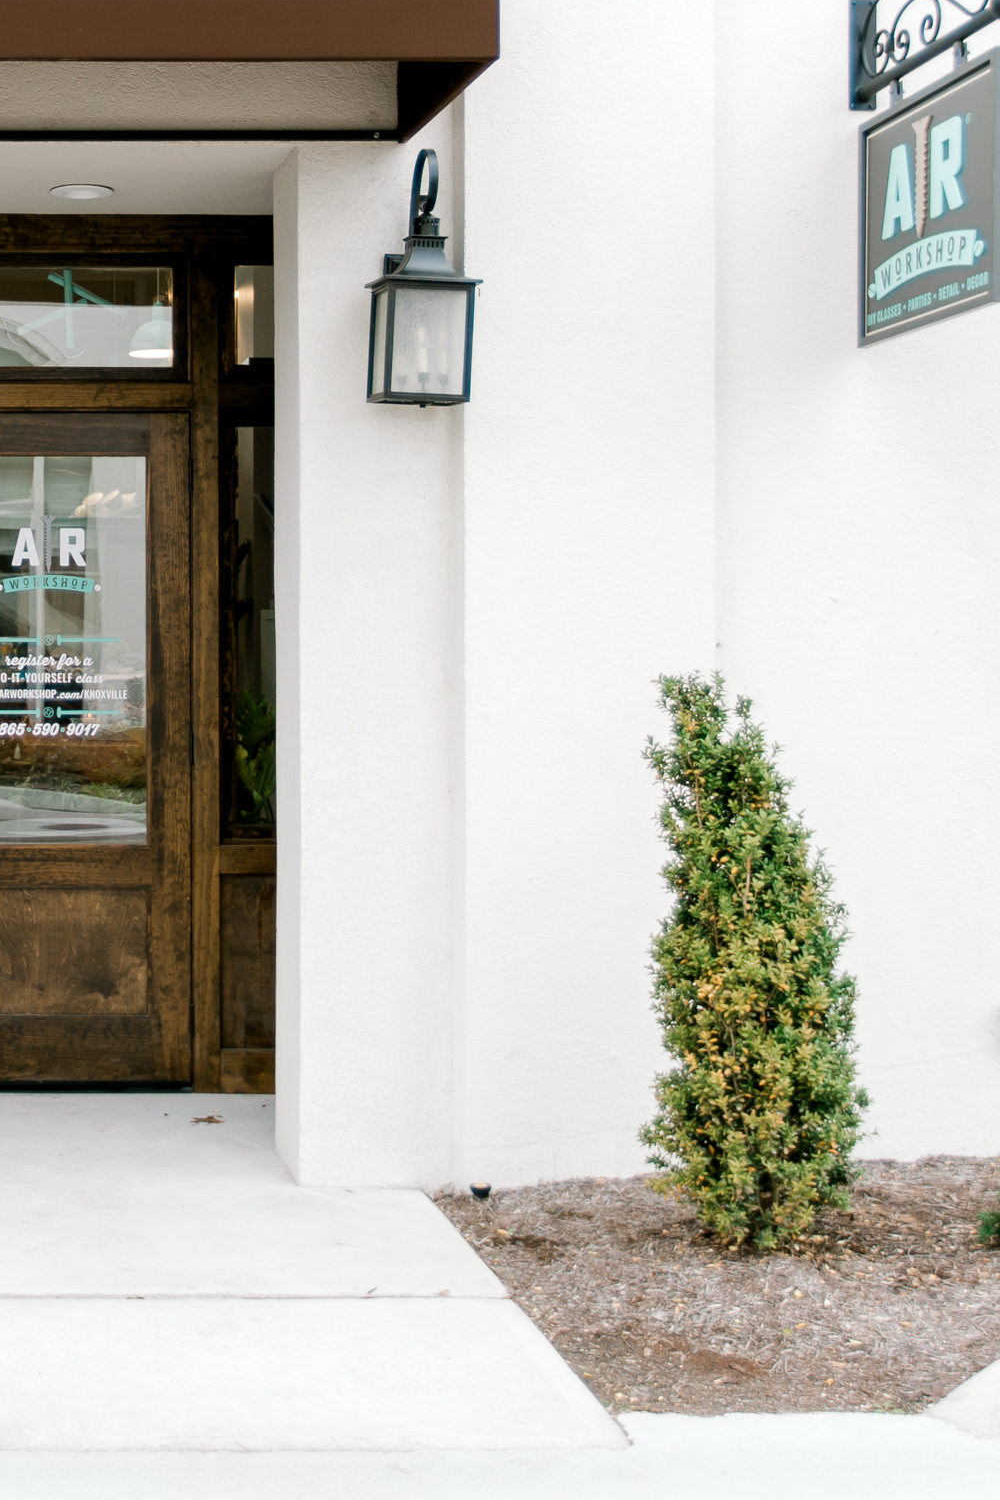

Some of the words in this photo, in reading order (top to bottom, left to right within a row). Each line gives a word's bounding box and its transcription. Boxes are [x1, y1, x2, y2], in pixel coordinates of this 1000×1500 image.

[882, 115, 965, 240] AR
[881, 236, 966, 290] WORKSHOP
[867, 312, 876, 326] DIY
[877, 303, 902, 323] CLASSES
[908, 291, 932, 312] PARTIES
[938, 282, 960, 301] RETAIL
[966, 271, 989, 291] DECOR
[11, 527, 87, 567] AR
[9, 577, 89, 590] WORKSHOP
[4, 653, 58, 670] register
[54, 653, 82, 671] for
[83, 657, 93, 667] a
[75, 672, 104, 684] class
